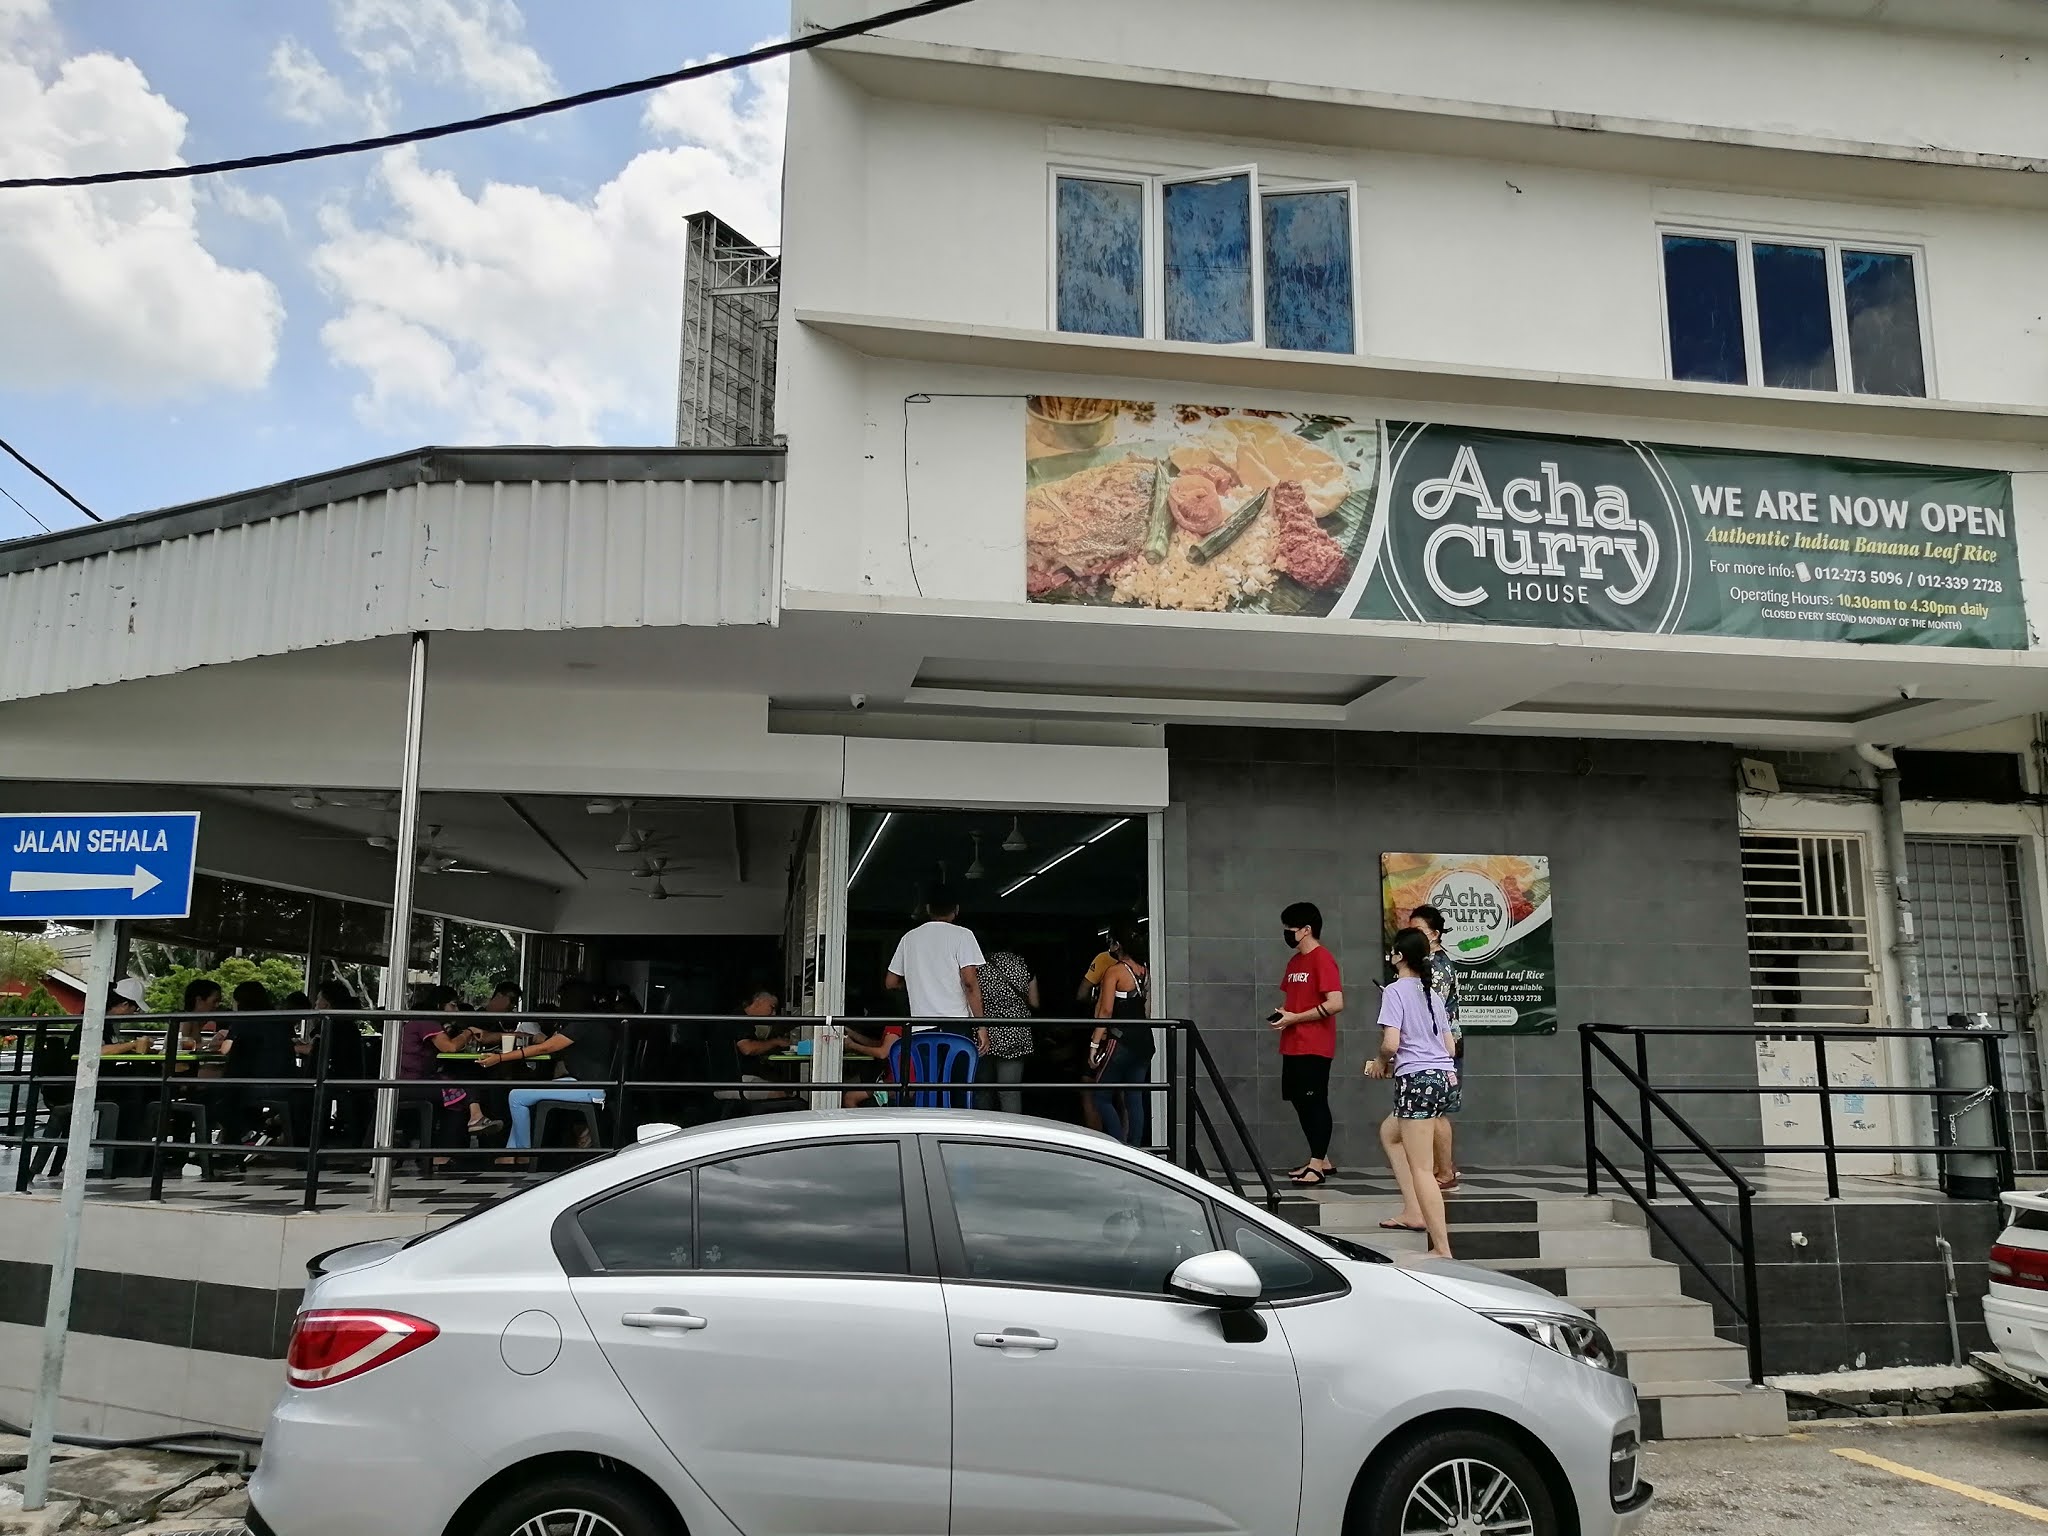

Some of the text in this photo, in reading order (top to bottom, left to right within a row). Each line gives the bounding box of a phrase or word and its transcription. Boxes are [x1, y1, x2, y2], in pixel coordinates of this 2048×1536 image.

[1412, 445, 1638, 531] Acha
[1691, 484, 2006, 538] WE ARE NOW OPEN
[1705, 526, 1997, 564] Authentic Indian Banana Leaf Rice
[1423, 520, 1660, 607] Curry
[1709, 560, 2003, 593] For more info: 012-273 5096 / 012-339 2728
[1507, 582, 1589, 604] HOUSE
[1729, 586, 1989, 620] Operating Hours: 10.30am to 4.30pm daily
[1761, 607, 1962, 631] (CLOSED EVERY SECOND MONDAY OF THE MONTH)
[13, 829, 169, 853] JALAN SEHALA
[1431, 883, 1497, 907] Acha
[1470, 970, 1504, 979] Banana
[1505, 970, 1527, 982] Leaf
[1526, 970, 1545, 980] Rice
[1478, 983, 1509, 992] Catering
[1510, 983, 1545, 991] available.
[1458, 994, 1480, 1002] 2-8277
[1481, 994, 1493, 1002] 346
[1499, 994, 1525, 1002] 012-339
[1526, 994, 1542, 1002] 2728
